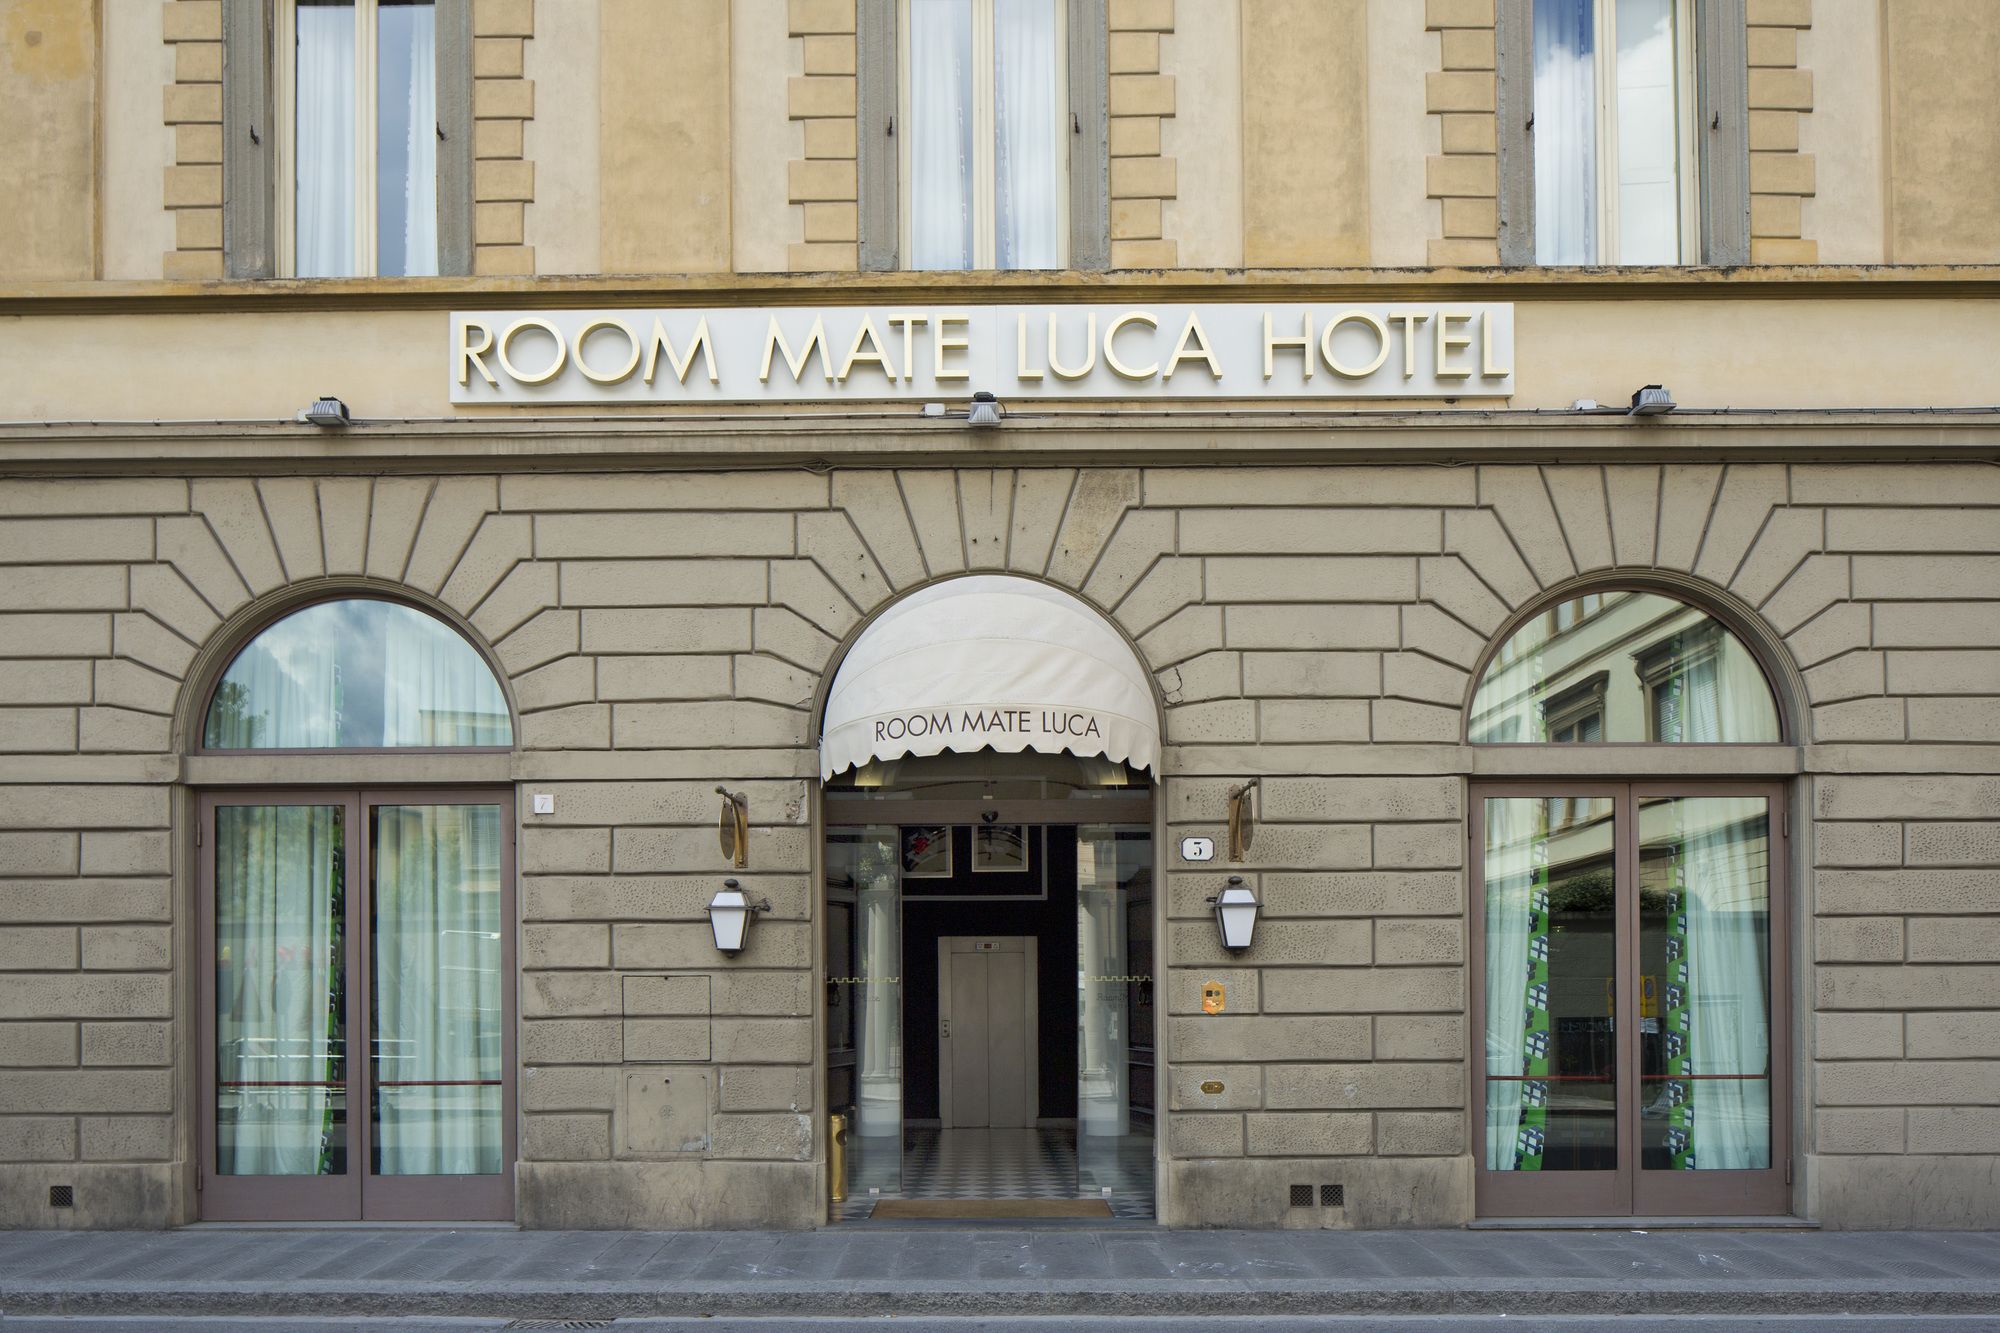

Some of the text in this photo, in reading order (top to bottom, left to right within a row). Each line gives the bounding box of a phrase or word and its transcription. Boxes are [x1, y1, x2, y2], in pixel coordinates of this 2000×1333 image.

[457, 309, 1510, 387] ROOM MATE LUCA HOTEL
[875, 710, 1101, 742] ROOM MATE LUCA
